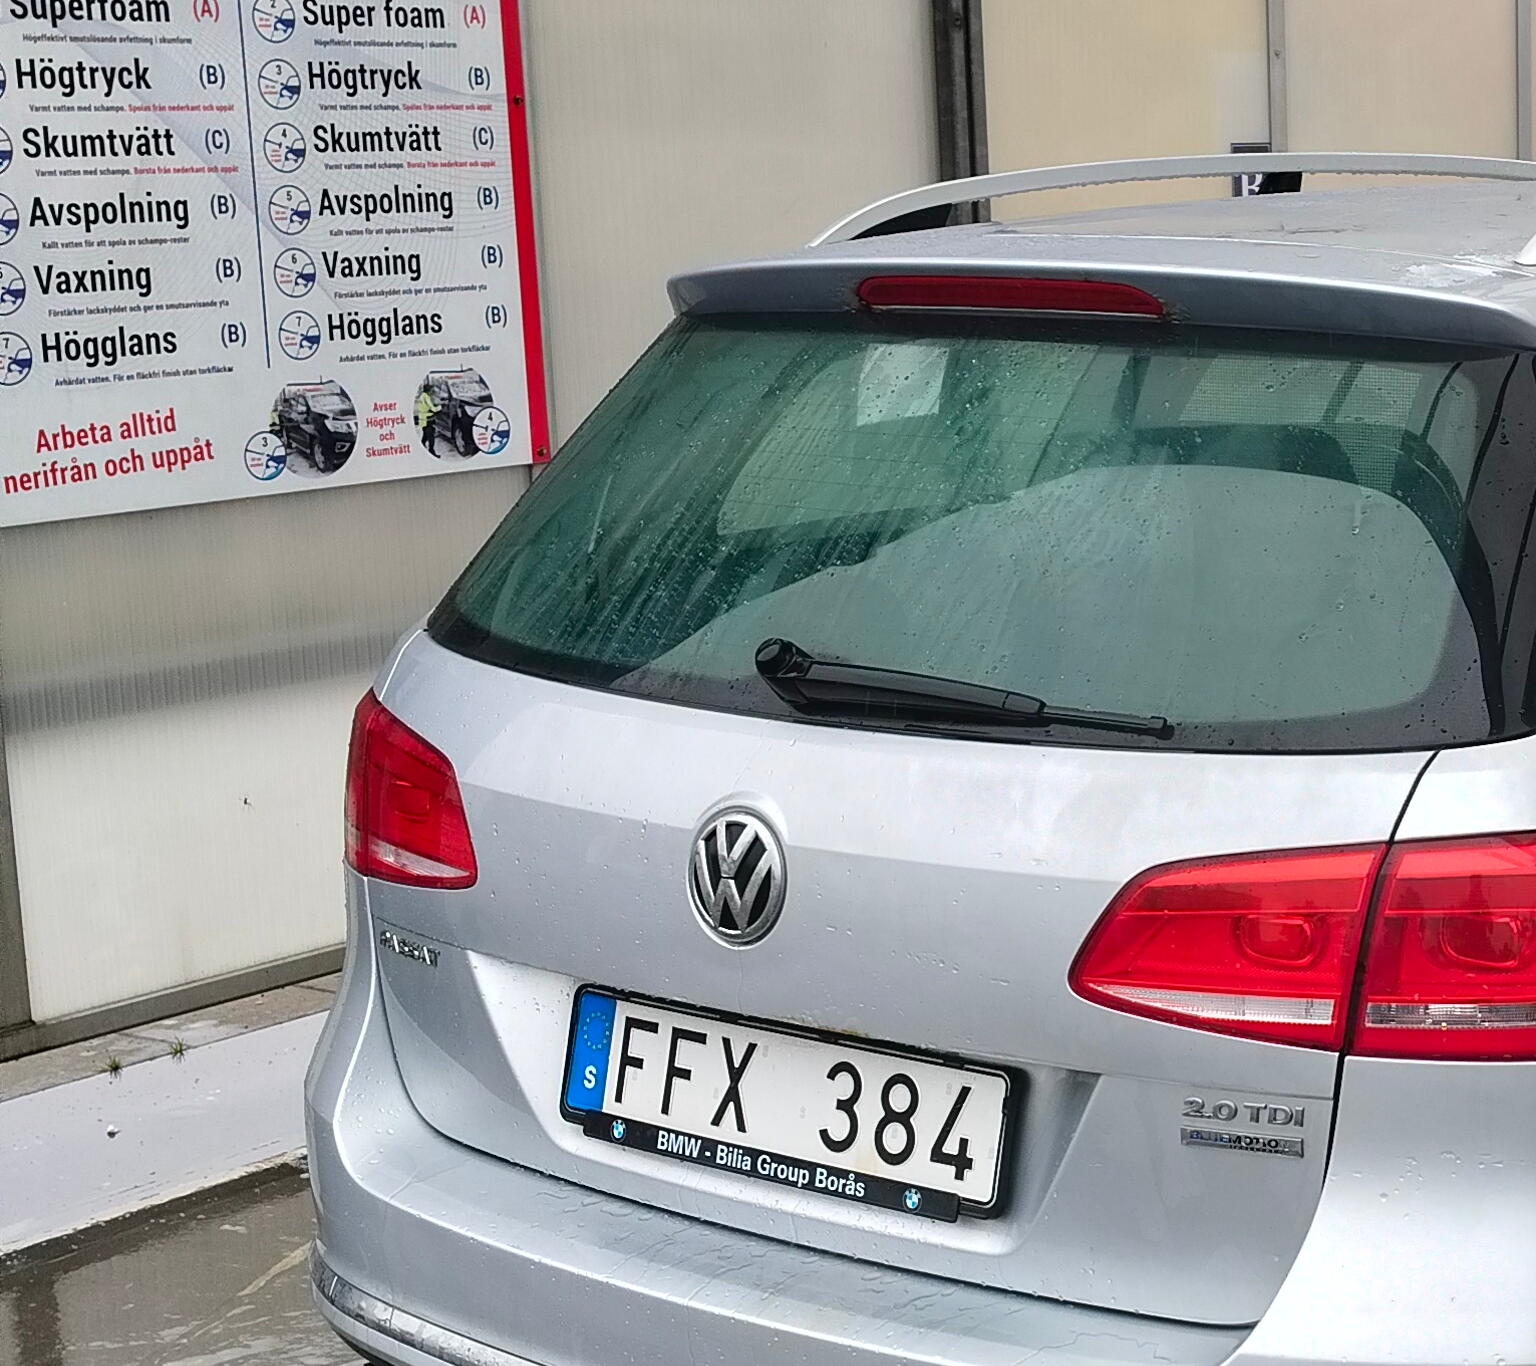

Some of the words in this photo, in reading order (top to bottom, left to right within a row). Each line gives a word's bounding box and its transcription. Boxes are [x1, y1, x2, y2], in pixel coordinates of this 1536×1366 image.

[463, 4, 486, 29] (A)
[15, 58, 152, 97] Högtryck
[199, 63, 225, 90] (B)
[307, 61, 422, 97] Högtryck
[468, 67, 490, 91] (B)
[22, 126, 175, 158] Skumtvätt
[205, 128, 230, 154] (C)
[313, 123, 442, 154] Skumtvätt
[472, 126, 494, 150] (C)
[211, 193, 236, 219] (B)
[319, 184, 453, 222] Avspolning
[477, 186, 499, 210] (B)
[29, 192, 189, 232] Avspolning
[216, 256, 241, 283] (B)
[322, 247, 421, 281] Vaxning
[481, 245, 503, 268] (B)
[33, 260, 152, 297] Vaxning
[328, 308, 442, 345] Högglans
[485, 305, 507, 329] (B)
[41, 326, 177, 367] Högglans
[221, 322, 246, 349] (B)
[372, 401, 397, 412] Avser
[36, 422, 112, 453] Arbeta
[119, 407, 176, 439] alltid
[366, 415, 406, 428] Högtryck
[379, 431, 395, 442] och
[366, 444, 411, 458] Skumtvätt
[4, 457, 97, 494] nerifrån
[105, 448, 145, 477] och
[152, 437, 214, 472] uppåt
[584, 1065, 597, 1090] S
[614, 1015, 758, 1133] FFX
[819, 1061, 974, 1181] 384
[1181, 1096, 1238, 1122] 2.0
[1243, 1102, 1305, 1127] TDI
[656, 1130, 701, 1158] BMW
[716, 1145, 752, 1170] Bilia
[757, 1154, 809, 1187] Group
[815, 1166, 866, 1198] Borås
